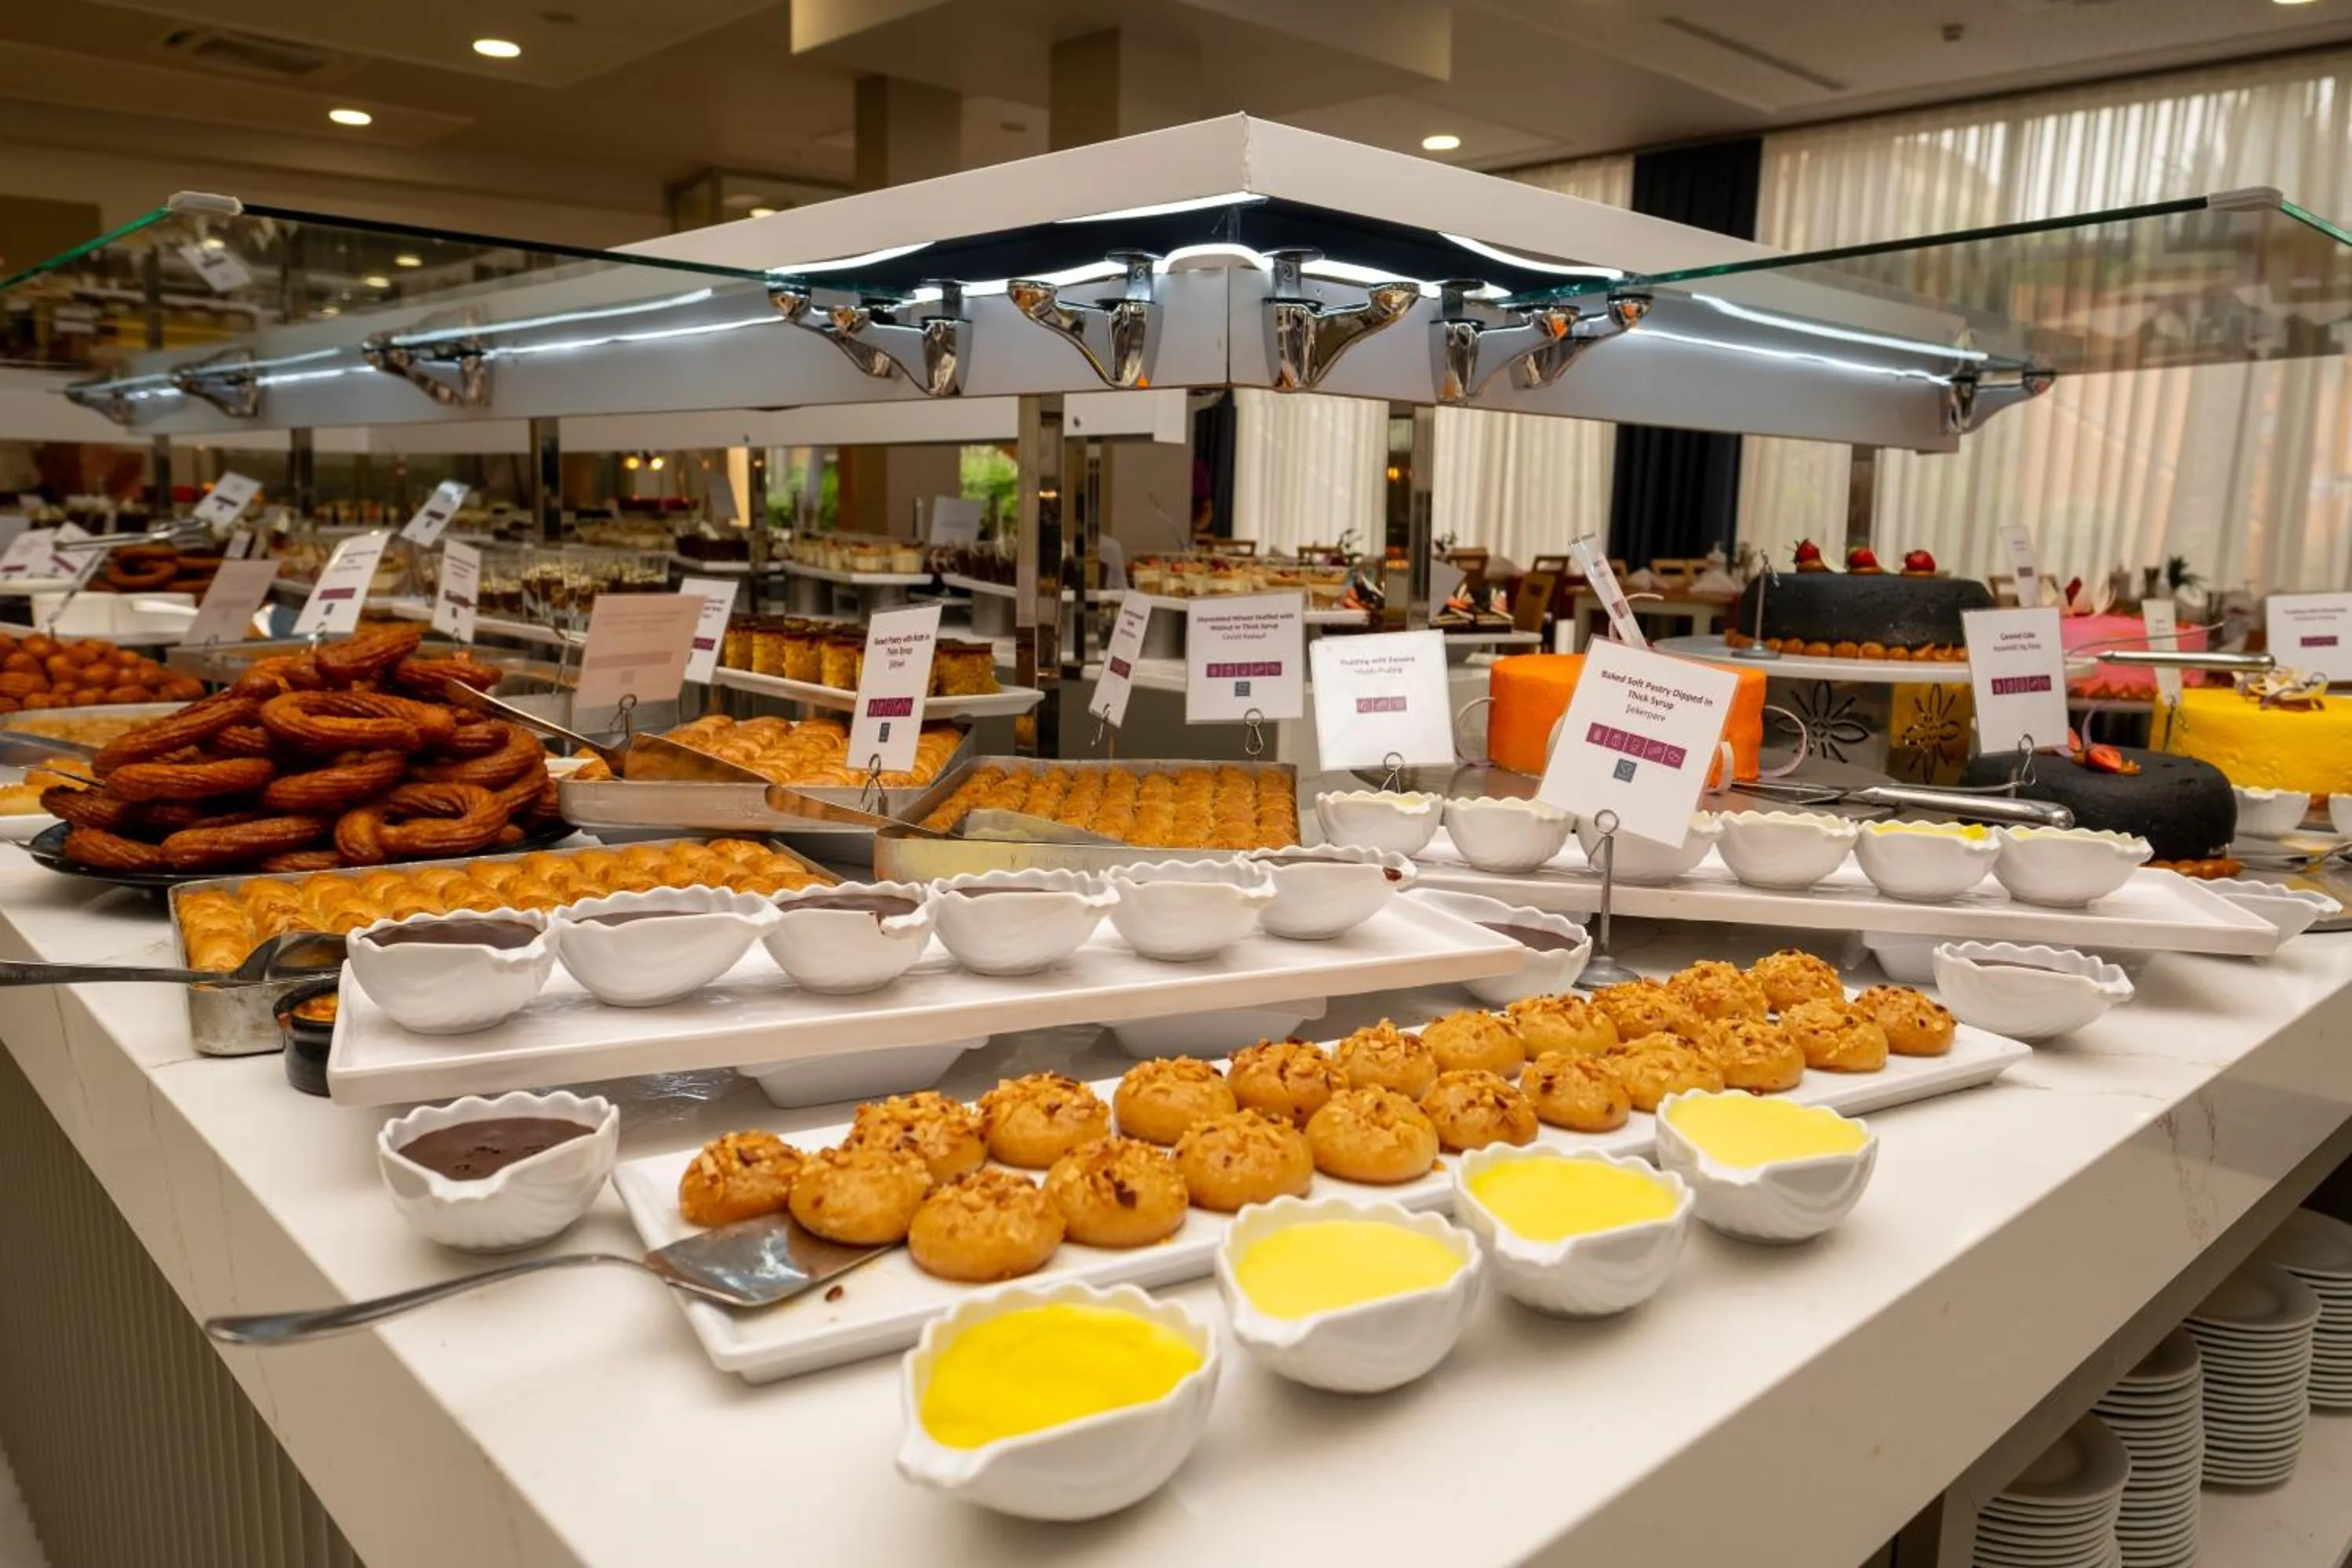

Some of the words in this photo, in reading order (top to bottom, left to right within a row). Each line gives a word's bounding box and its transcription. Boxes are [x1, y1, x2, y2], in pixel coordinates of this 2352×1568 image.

[1601, 669, 1627, 684] Baked
[1627, 677, 1645, 688] Soft
[1645, 681, 1672, 696] Pastry
[1672, 688, 1704, 704] Dipped
[1704, 696, 1714, 706] in
[1628, 690, 1649, 703] Thick
[1650, 695, 1675, 710] Syrup
